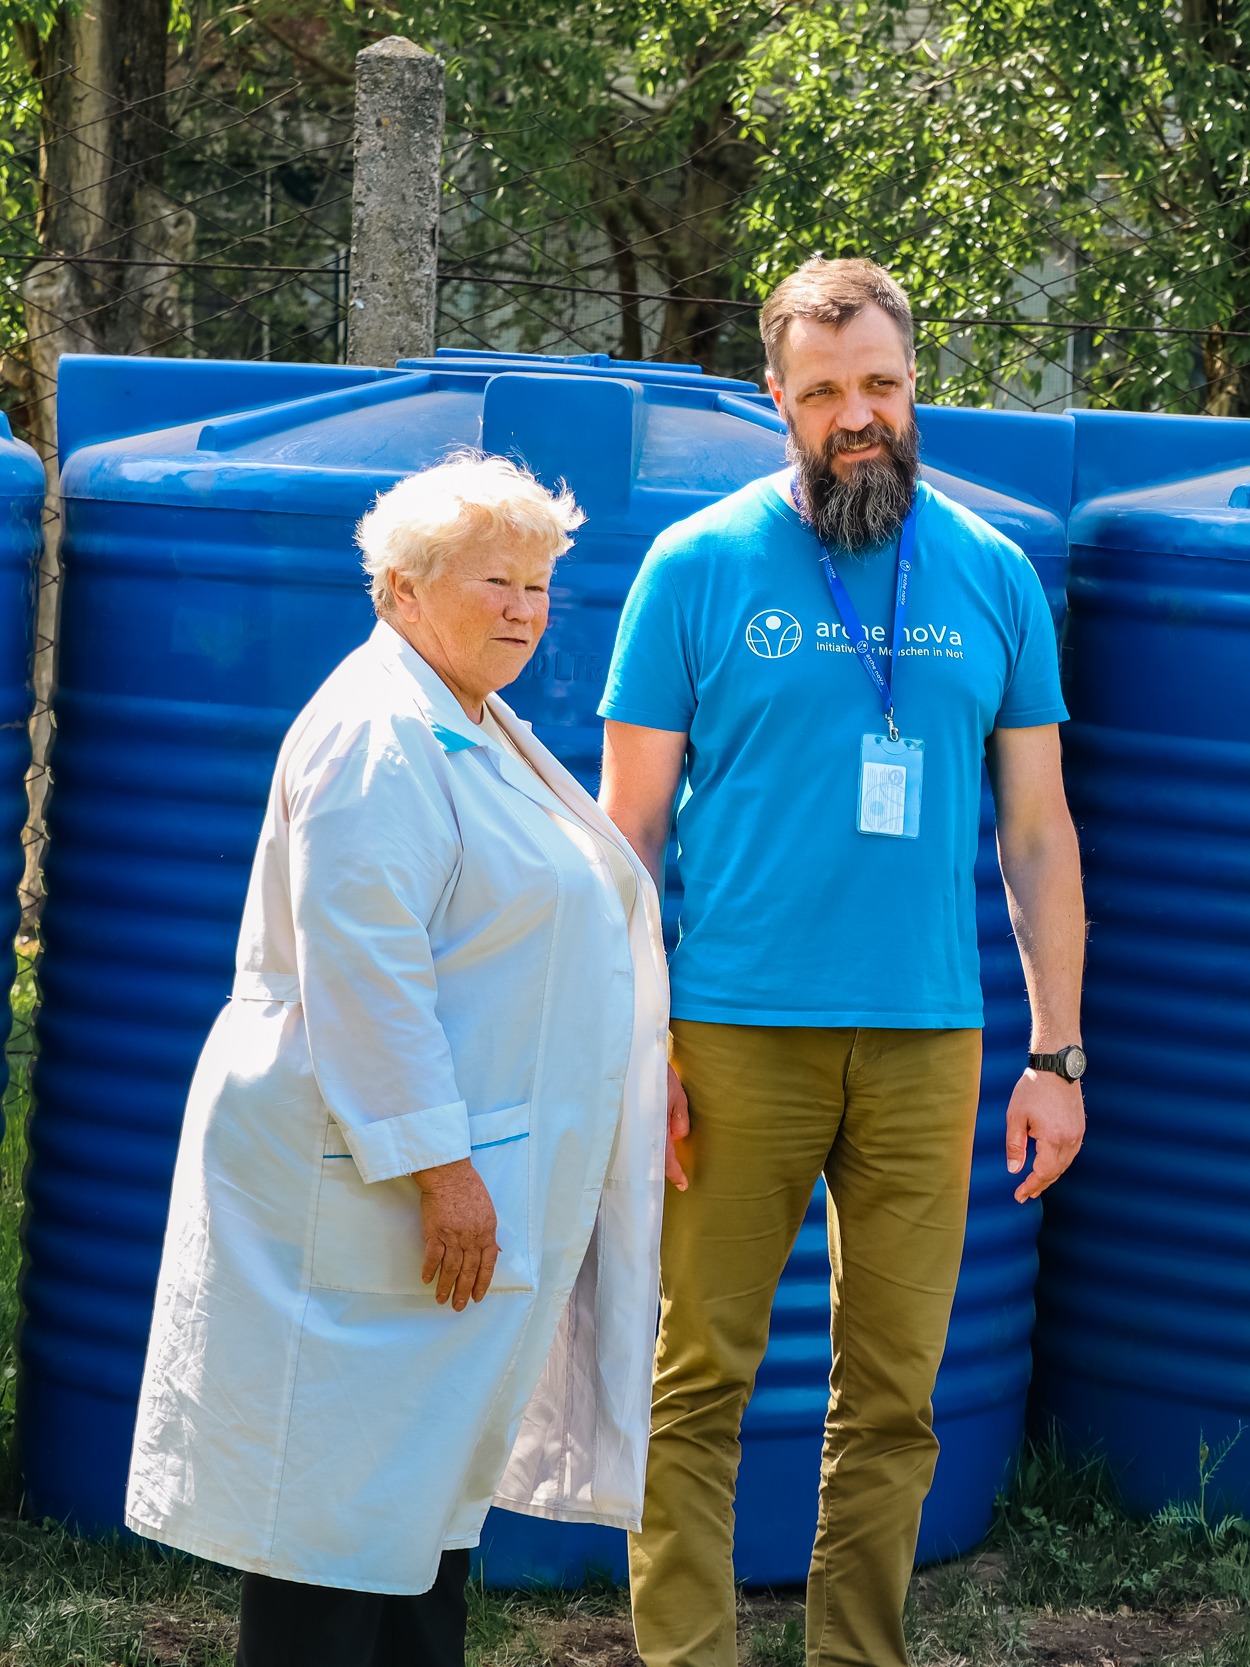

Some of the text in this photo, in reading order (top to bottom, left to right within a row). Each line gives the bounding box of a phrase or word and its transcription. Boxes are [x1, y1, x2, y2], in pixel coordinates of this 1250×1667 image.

[933, 647, 943, 657] in
[946, 648, 964, 660] Not
[866, 654, 877, 670] arche
[874, 670, 884, 686] noVa
